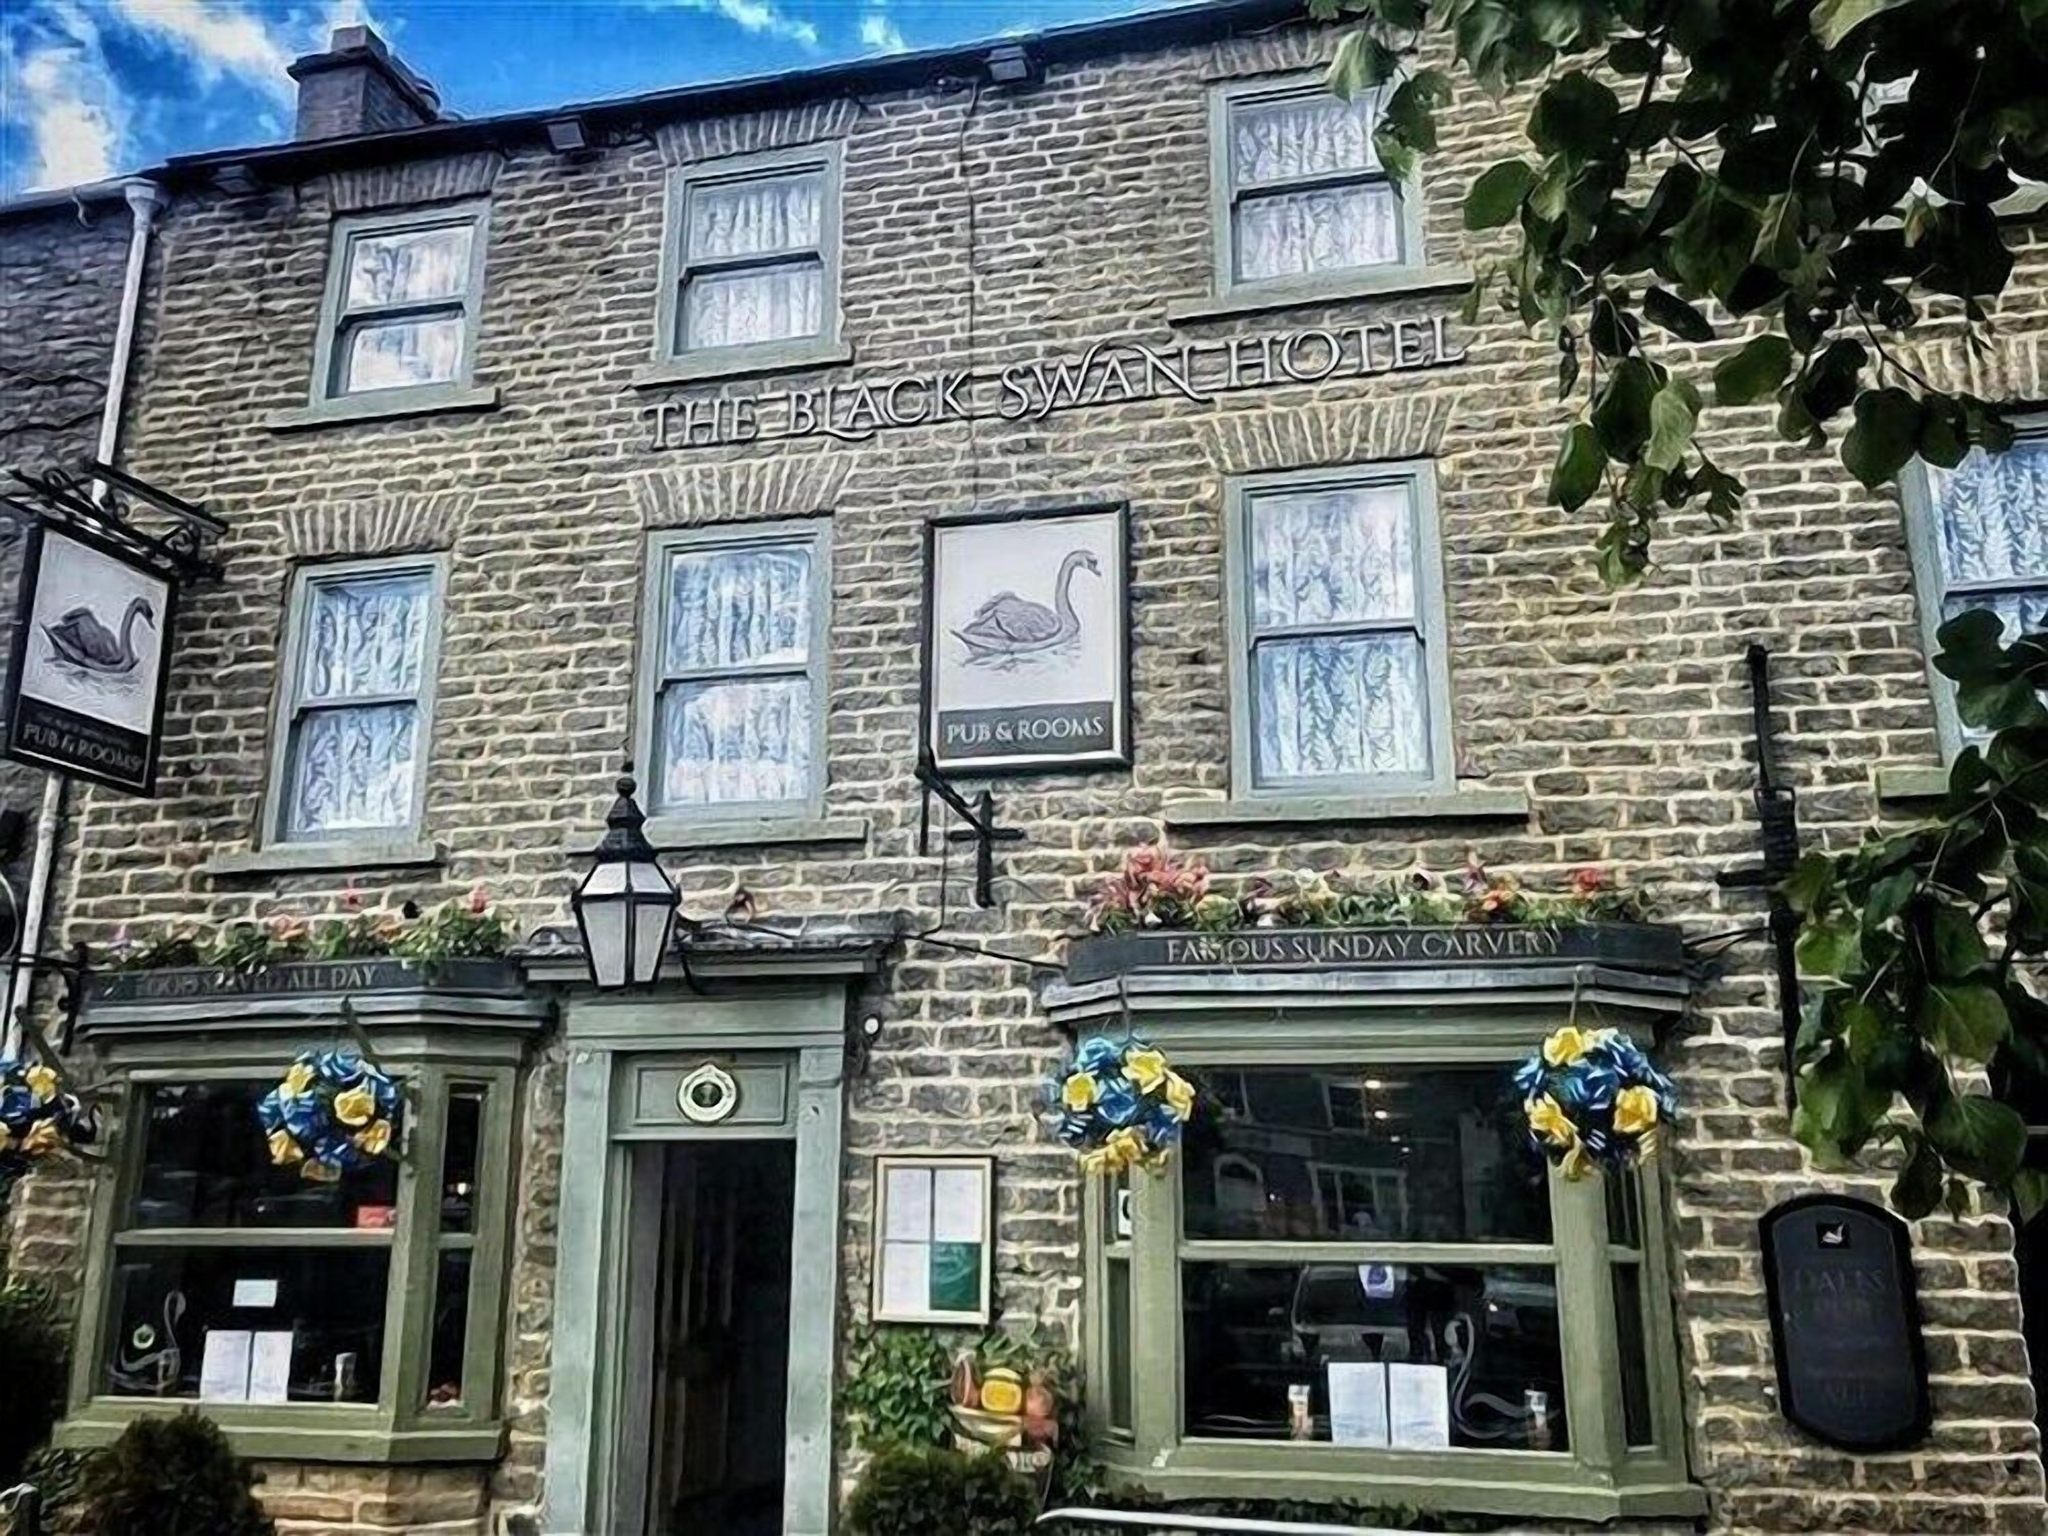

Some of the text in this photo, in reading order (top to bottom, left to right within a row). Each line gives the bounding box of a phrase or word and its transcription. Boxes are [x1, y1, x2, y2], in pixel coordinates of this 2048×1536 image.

[643, 314, 1467, 450] THE BLACK SWAN HOTEL
[22, 723, 60, 749] PUB
[946, 716, 1105, 744] PUB & ROOMS
[1167, 928, 1562, 963] FAMOUS SUNDAY CARVERY
[287, 965, 326, 989] ALL
[330, 964, 377, 989] DAY
